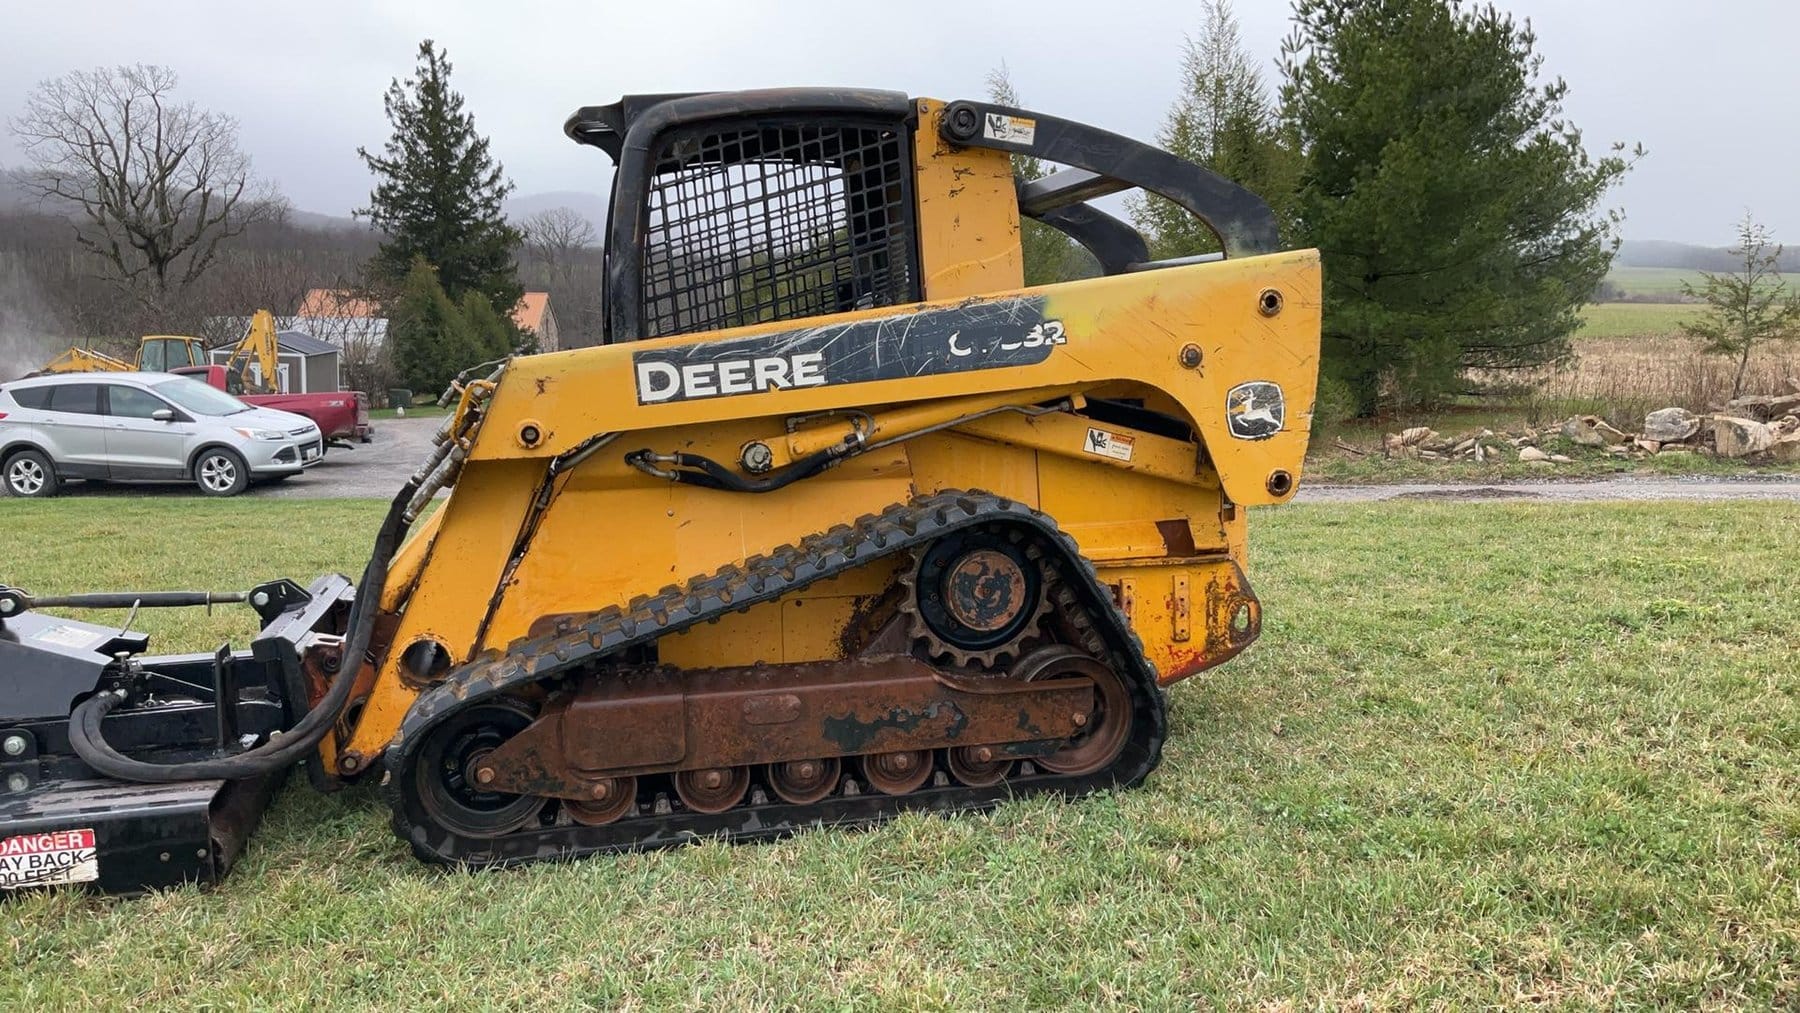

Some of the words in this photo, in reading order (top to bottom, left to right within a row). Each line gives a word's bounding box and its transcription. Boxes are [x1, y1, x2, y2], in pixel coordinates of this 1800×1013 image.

[948, 321, 1067, 356] C32
[637, 352, 826, 402] DEERE
[29, 850, 84, 868] BACK
